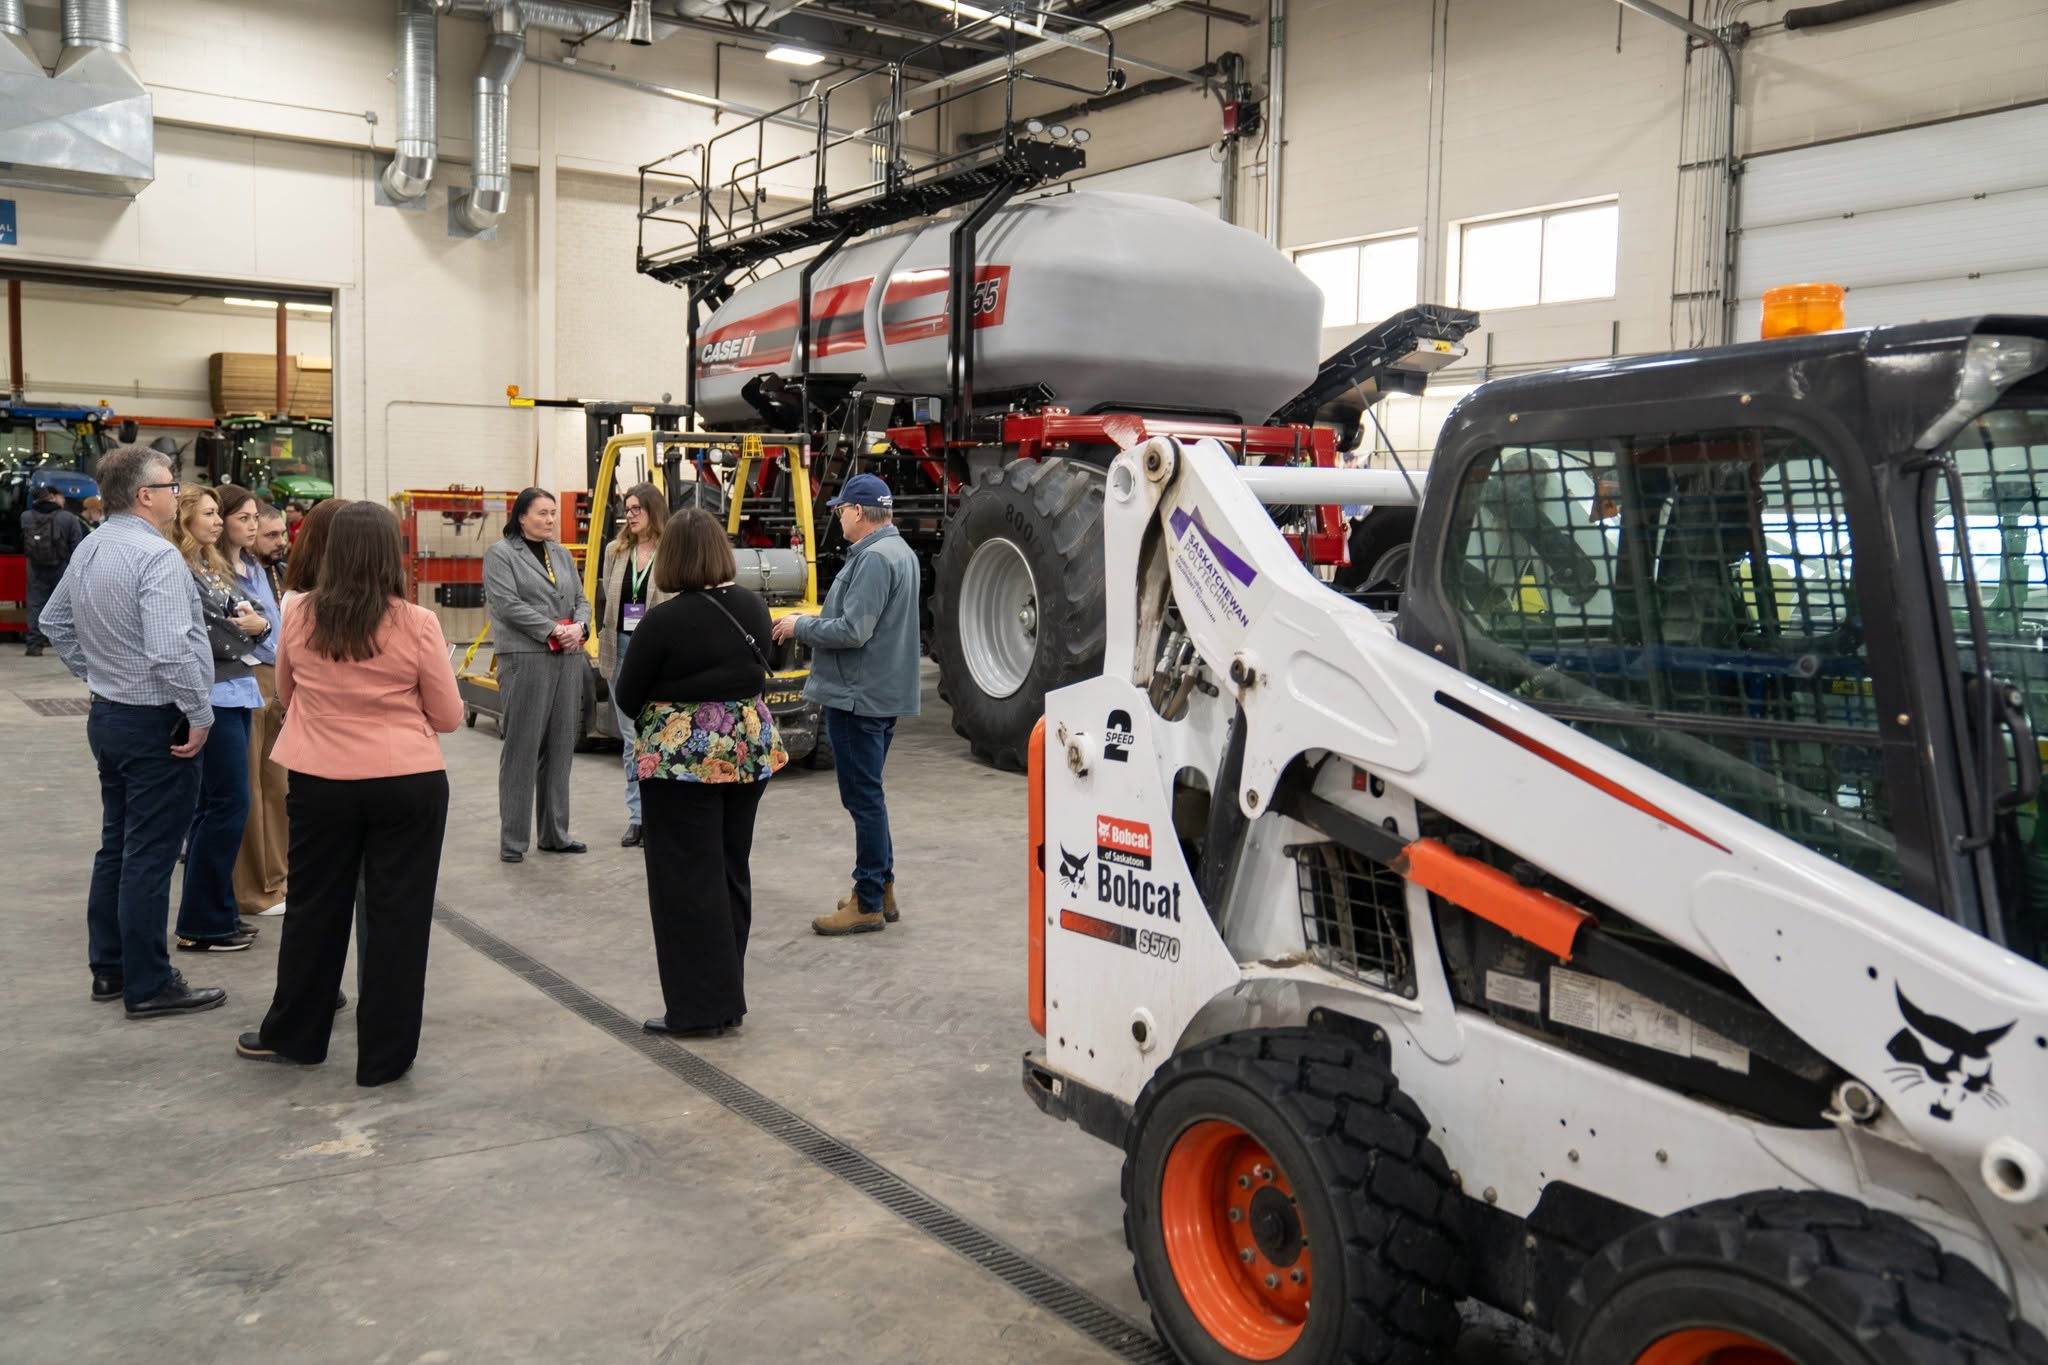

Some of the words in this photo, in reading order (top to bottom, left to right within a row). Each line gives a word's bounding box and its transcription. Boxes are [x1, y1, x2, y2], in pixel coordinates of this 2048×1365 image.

[1183, 543, 1234, 621] POLYTECHNIC
[1189, 534, 1249, 627] SASKATCHEWAN
[1104, 709, 1132, 763] 2
[1105, 731, 1135, 745] SPEED
[1104, 850, 1112, 860] of
[1112, 851, 1145, 868] Saskatoon
[1112, 825, 1150, 850] Bobcat
[1098, 862, 1181, 923] Bobcat
[1139, 928, 1181, 963] S570
